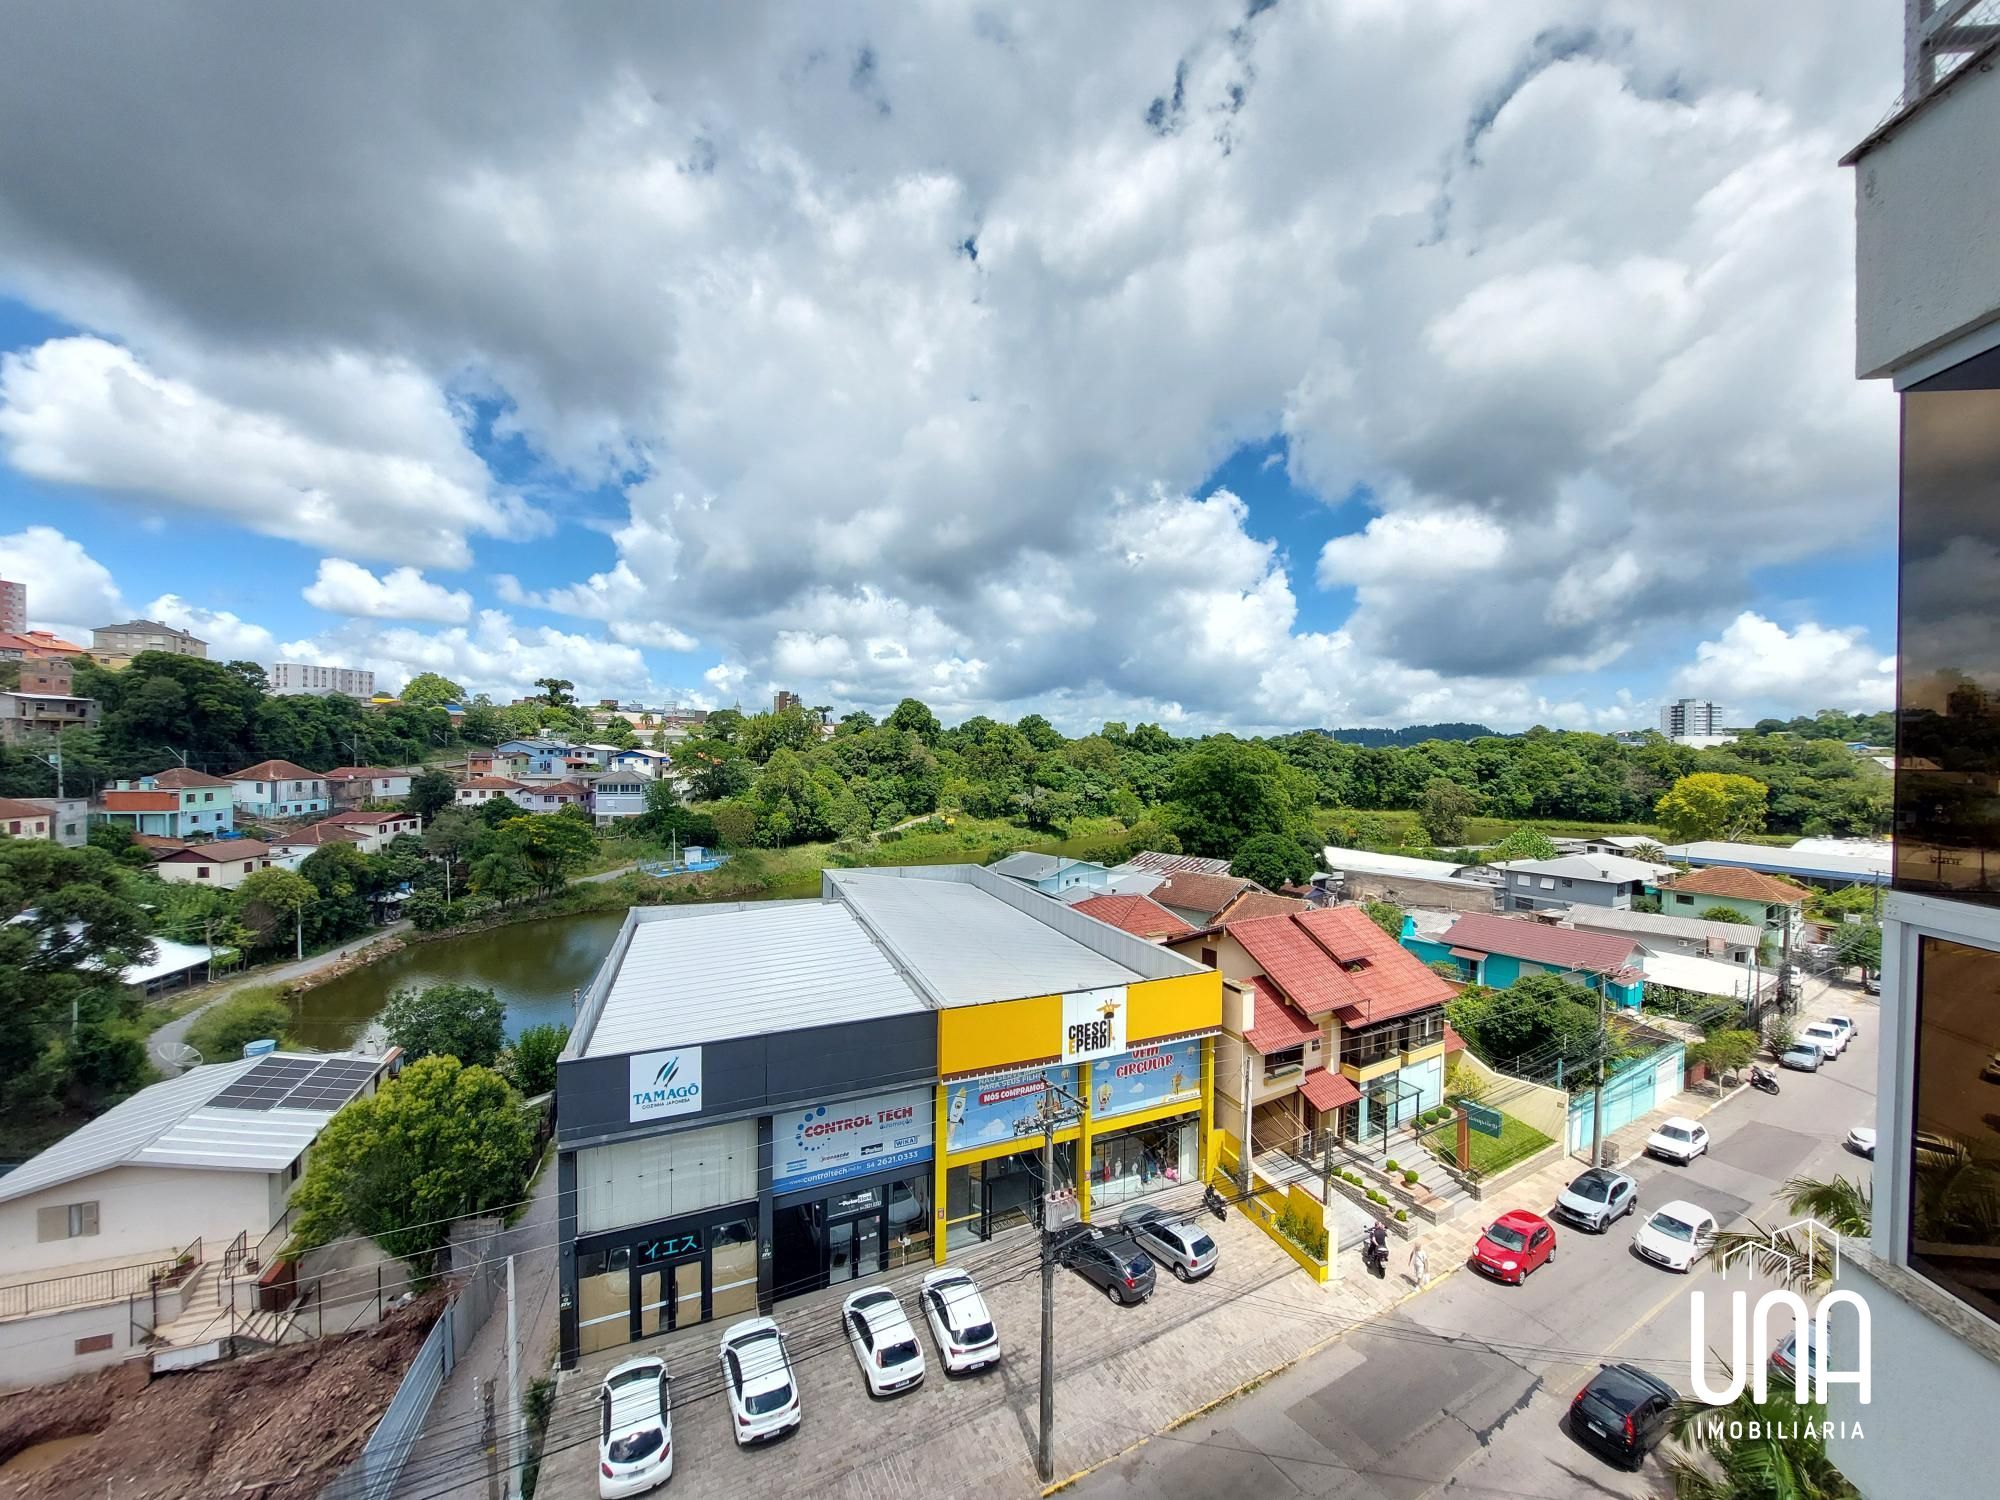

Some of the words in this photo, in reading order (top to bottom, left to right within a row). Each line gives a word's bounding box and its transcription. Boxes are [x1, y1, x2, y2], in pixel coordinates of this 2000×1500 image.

[1068, 1019, 1111, 1040] CRESCI
[1116, 1054, 1174, 1079] CIRCULAR
[979, 1081, 1000, 1091] PARA
[1001, 1077, 1021, 1087] SEUS
[983, 1092, 1000, 1103] NÓS
[1000, 1082, 1045, 1099] COMPRAMOS
[804, 1114, 873, 1138] CONTROL
[877, 1106, 913, 1124] TECH
[877, 1151, 919, 1166] 2621.0333
[645, 1235, 697, 1259] イエス
